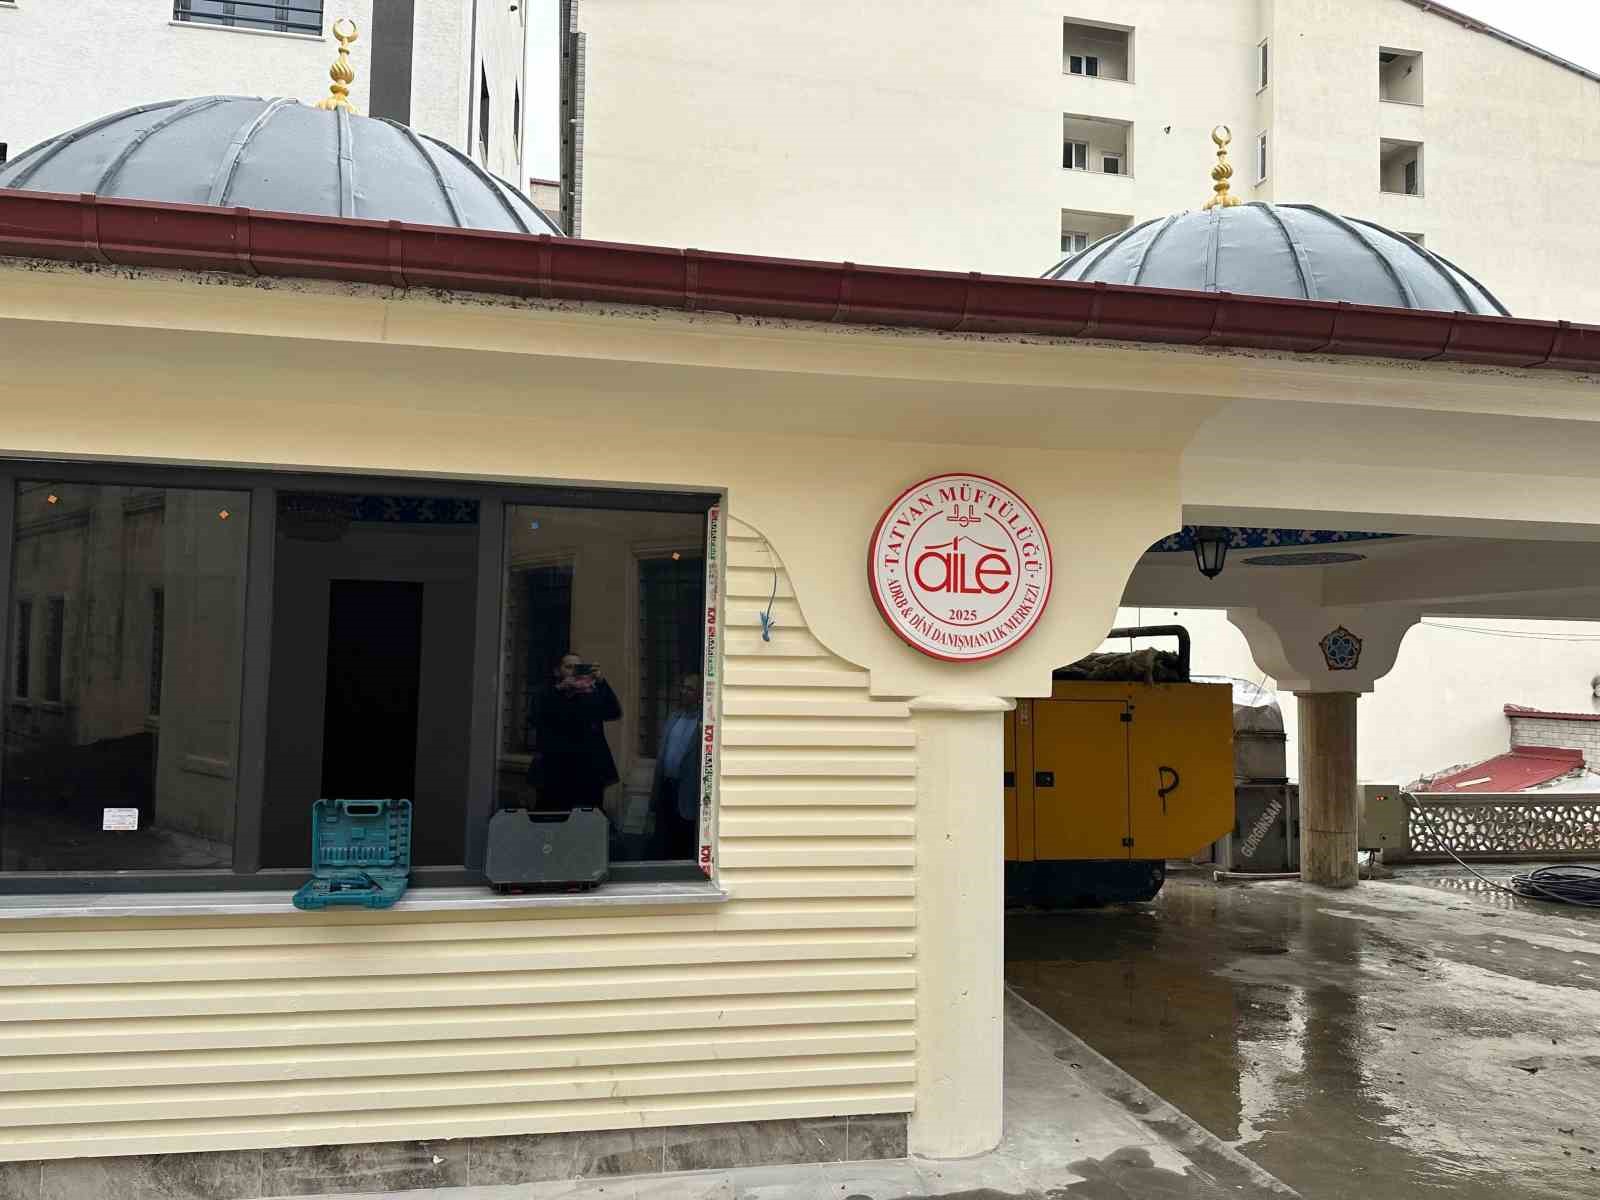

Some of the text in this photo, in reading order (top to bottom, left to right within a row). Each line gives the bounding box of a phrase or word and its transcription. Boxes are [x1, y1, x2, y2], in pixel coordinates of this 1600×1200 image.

[884, 483, 1043, 577] TATVAN MÜFTÜLÜĞÜ
[909, 614, 934, 637] DİNİ
[931, 625, 1007, 651] DANIŞMANLIK
[1004, 583, 1041, 632] MERKEZİ
[949, 608, 977, 621] 2025
